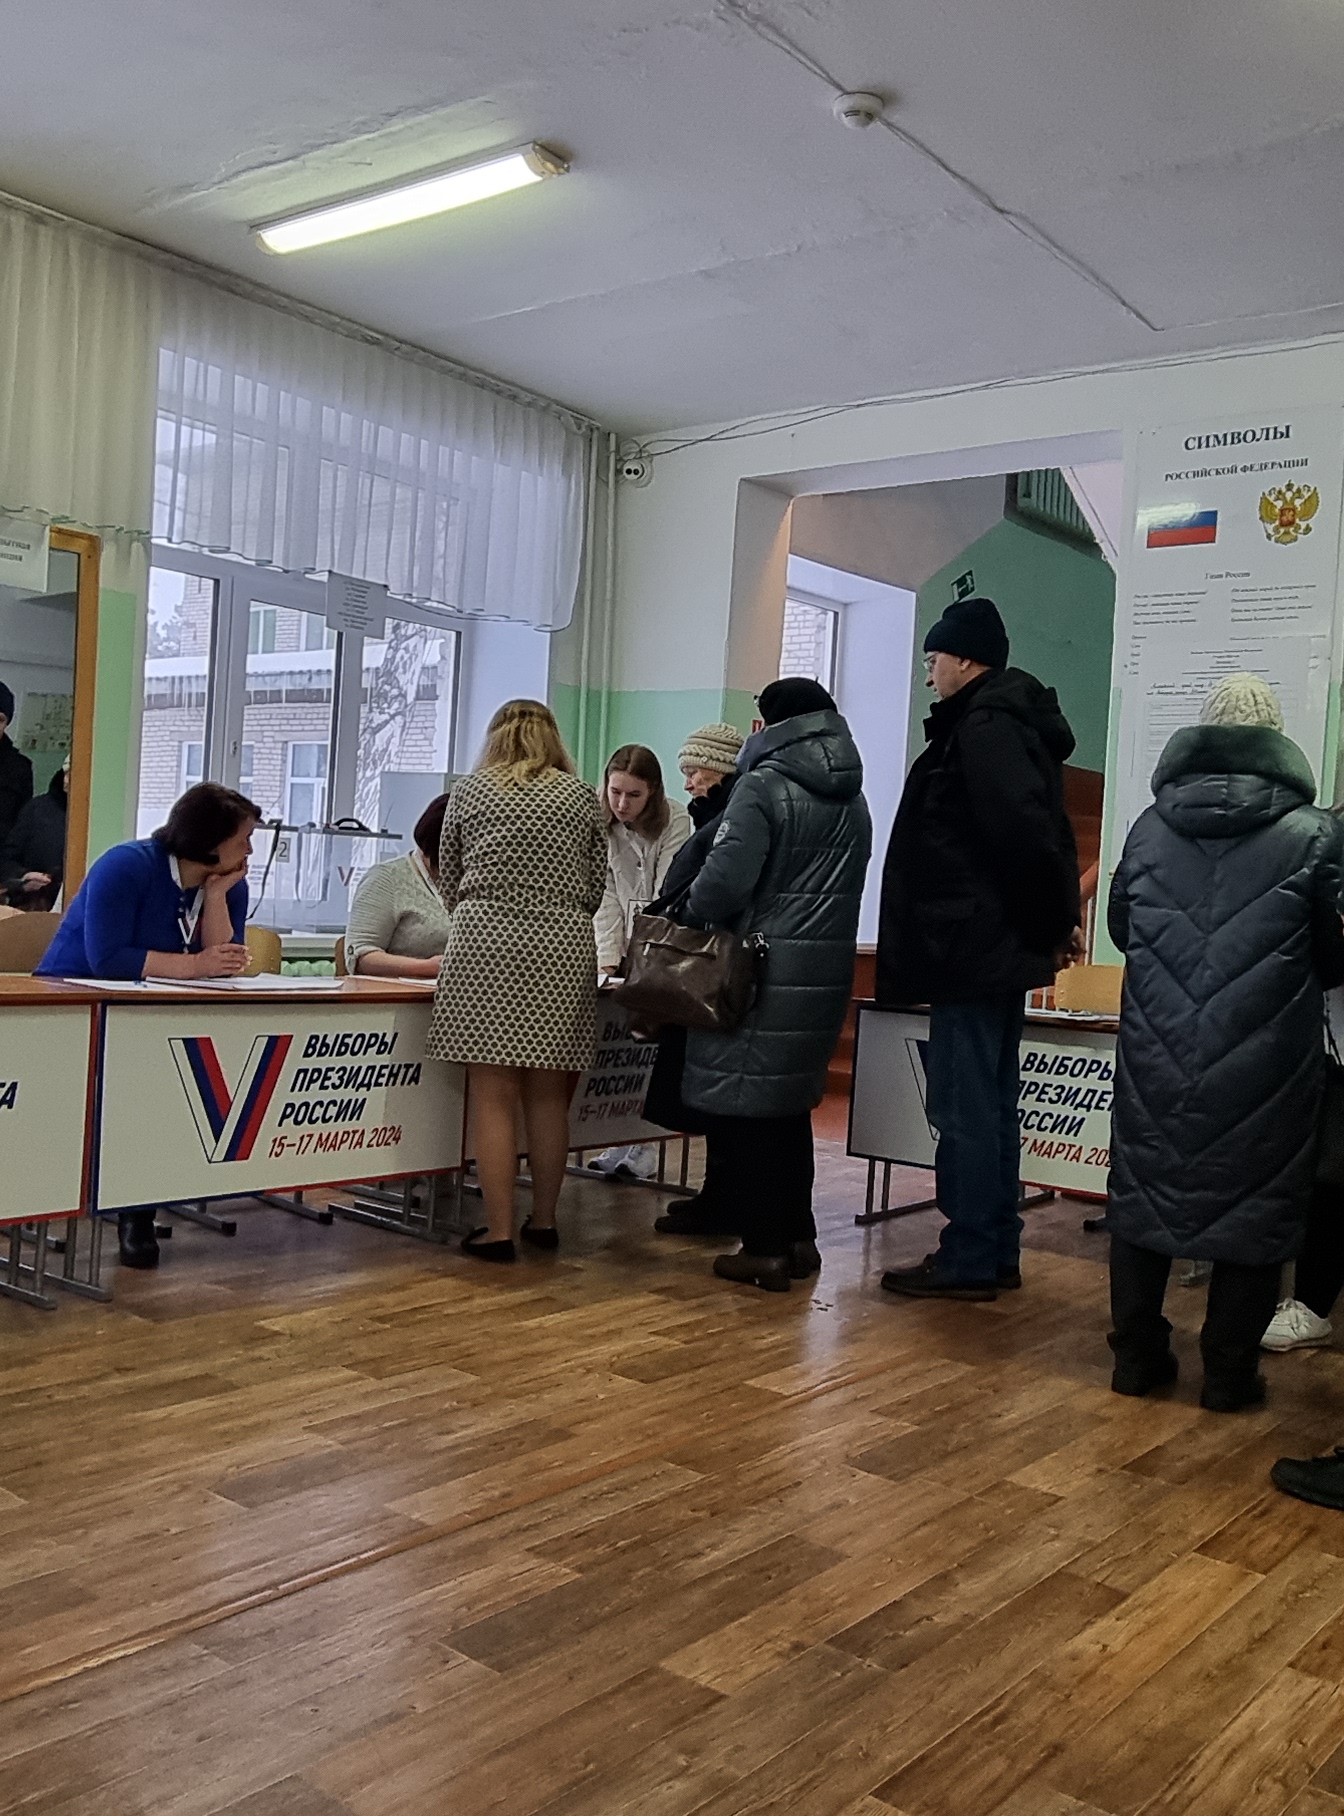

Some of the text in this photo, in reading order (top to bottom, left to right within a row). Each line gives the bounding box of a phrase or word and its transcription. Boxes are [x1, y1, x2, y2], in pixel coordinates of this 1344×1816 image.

[1183, 424, 1292, 451] СИМВОЛЫ
[1164, 457, 1309, 482] РОССИЙСКОЙ ФЕДЕРАЦИИ
[278, 841, 288, 858] 2
[303, 1032, 398, 1058] ВЫБОРЫ
[290, 1062, 422, 1093] ПРЕЗИДЕНТА
[584, 1073, 646, 1098] РОССИИ
[278, 1098, 367, 1127] РОССИИ
[313, 1127, 365, 1154] МАРТА
[366, 1125, 403, 1149] 2024
[1027, 1138, 1084, 1163] МАРТА
